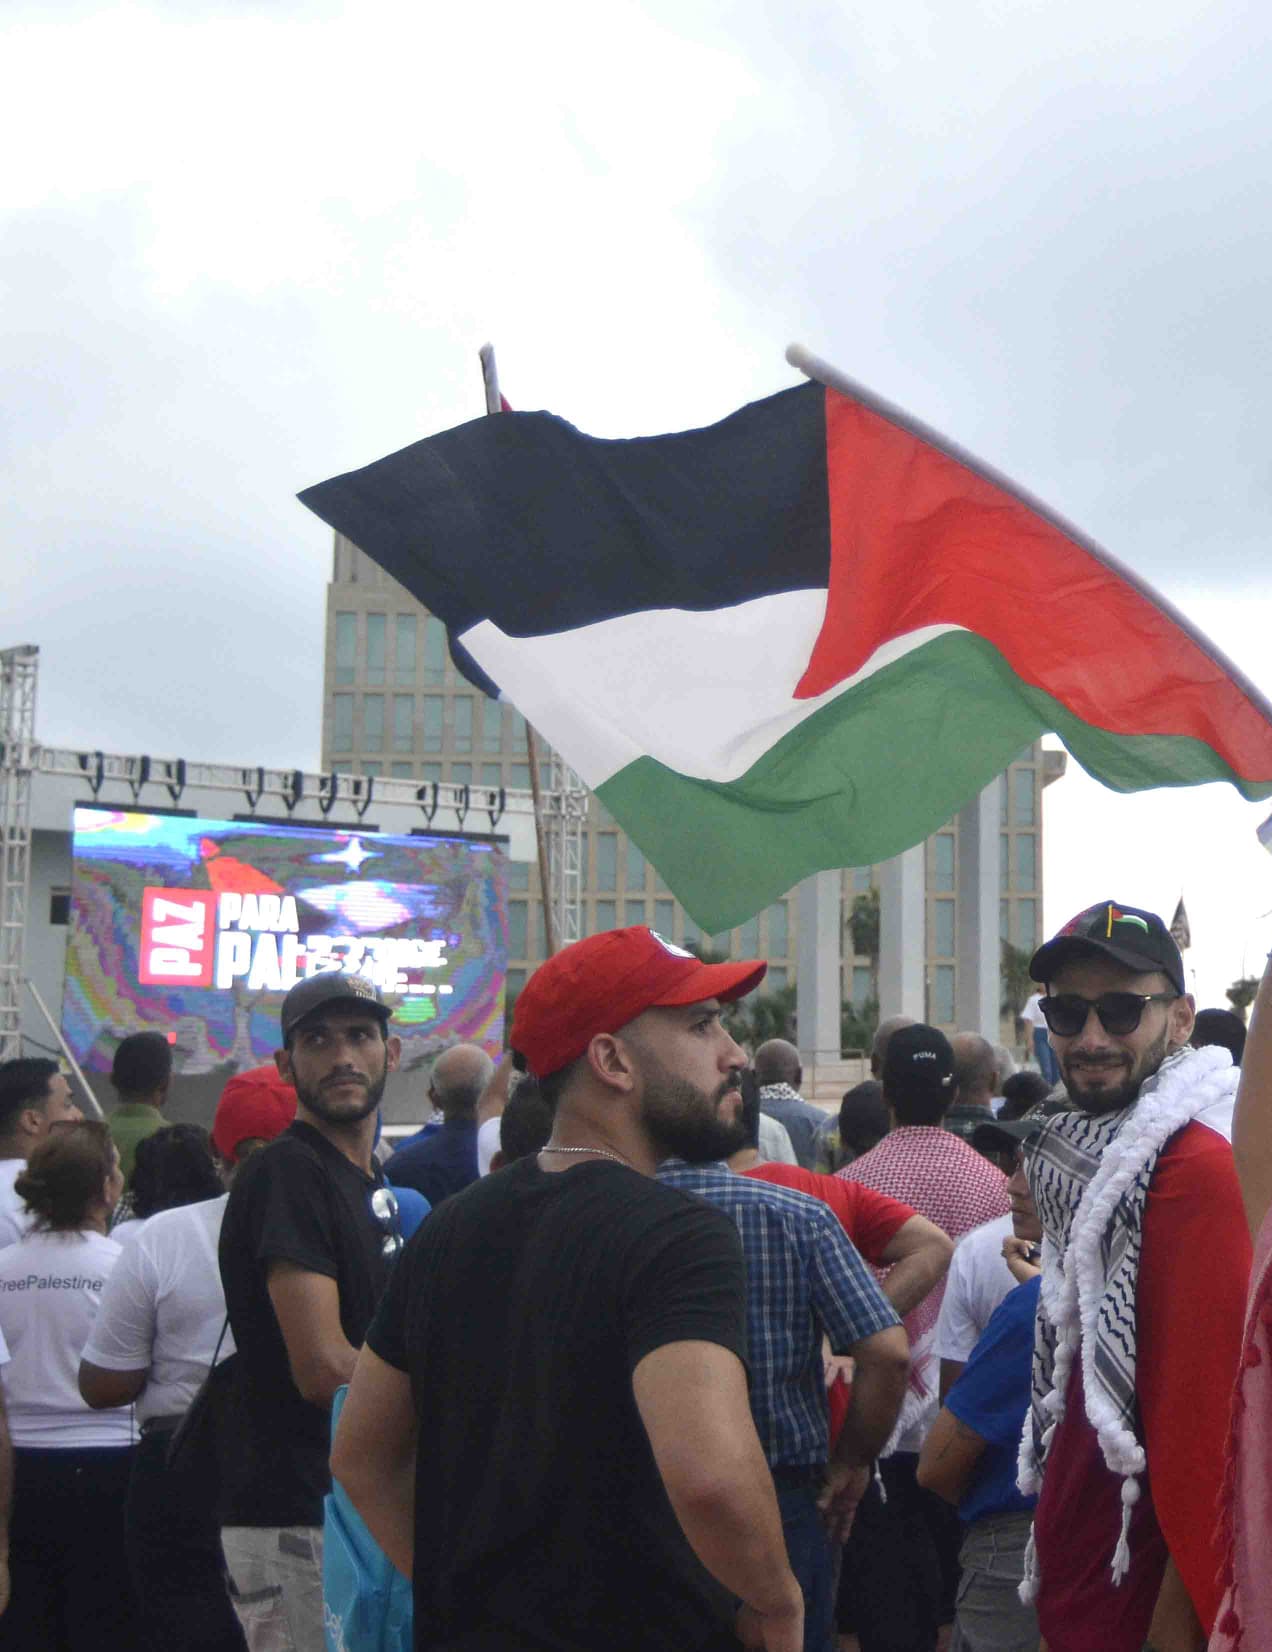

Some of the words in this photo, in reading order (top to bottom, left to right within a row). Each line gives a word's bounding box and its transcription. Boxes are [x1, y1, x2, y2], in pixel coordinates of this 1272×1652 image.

[218, 892, 299, 932] PARA
[149, 897, 206, 976] PAZ
[912, 1051, 937, 1061] PUMA
